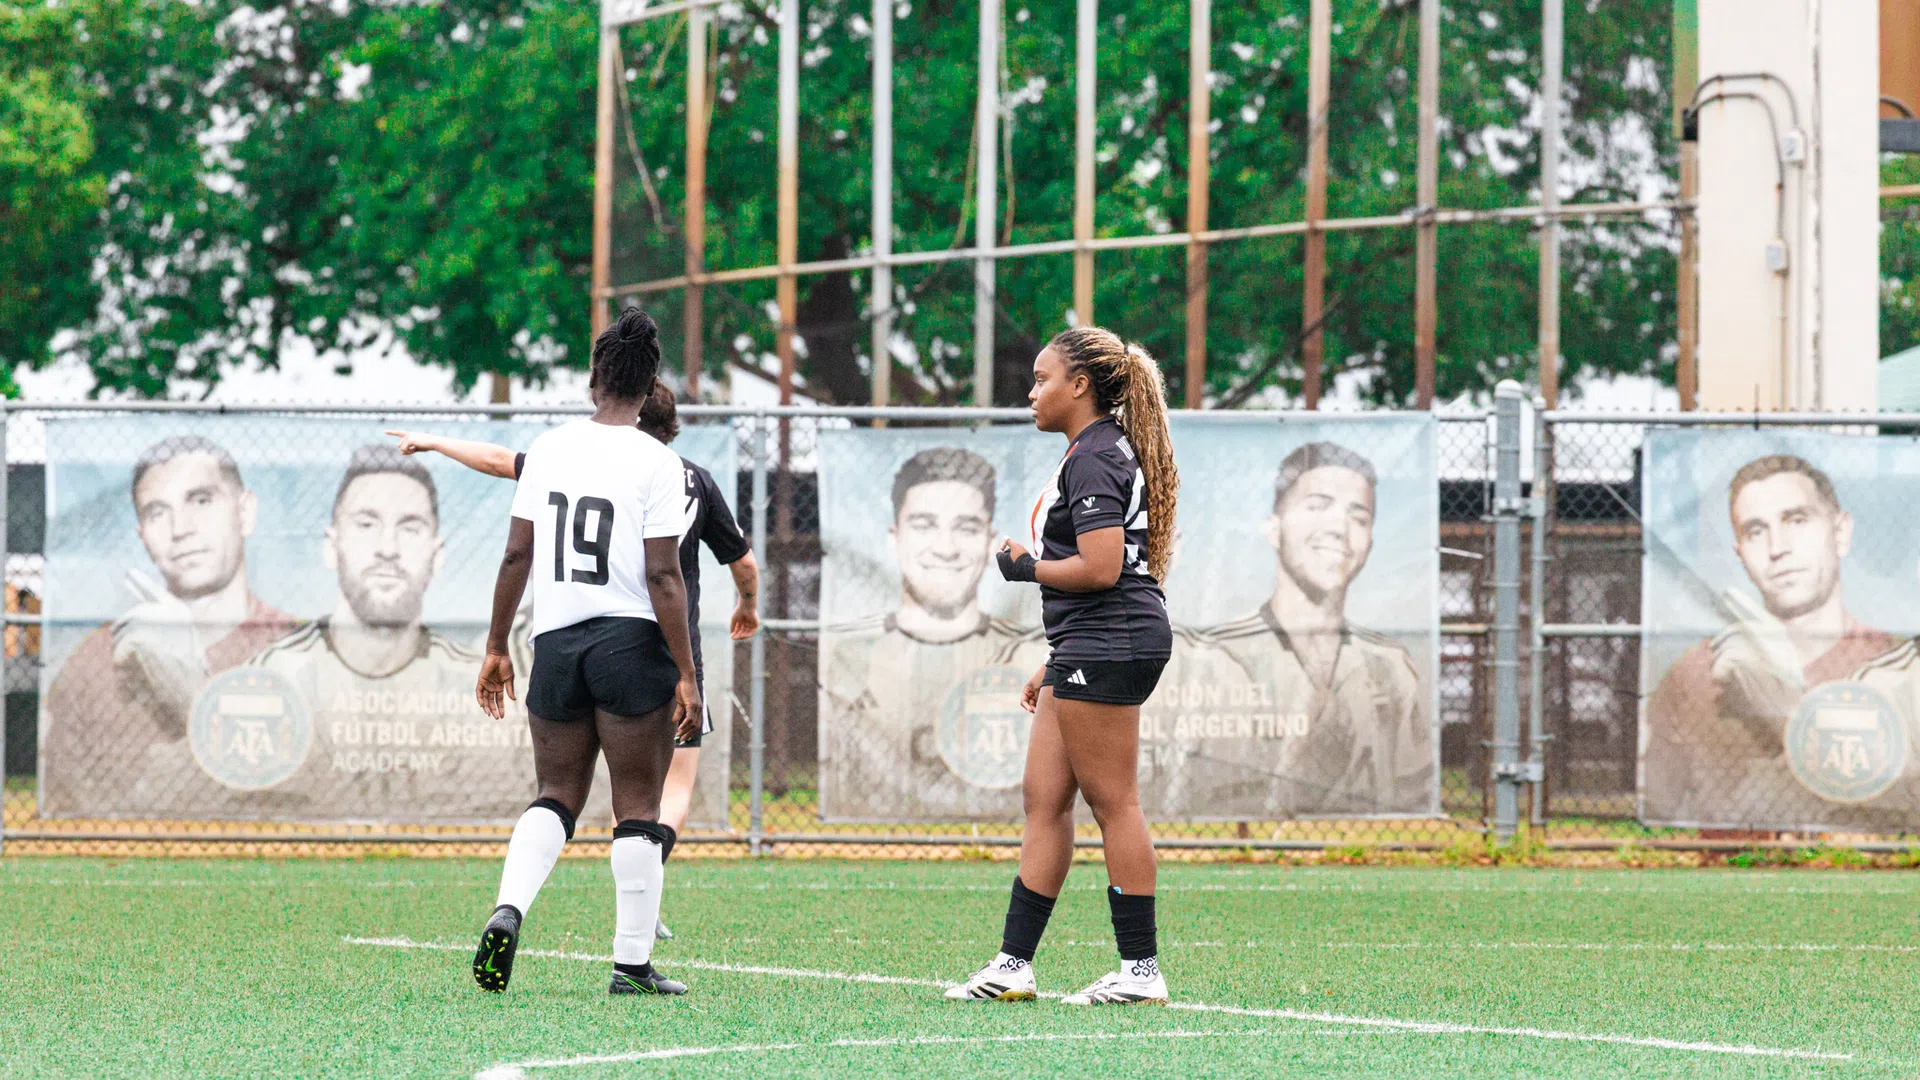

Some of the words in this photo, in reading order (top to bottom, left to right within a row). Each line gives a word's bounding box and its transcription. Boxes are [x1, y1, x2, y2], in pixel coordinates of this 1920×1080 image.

[548, 491, 615, 586] 19
[1230, 683, 1273, 706] DEL
[331, 716, 422, 745] FÚTBOL
[428, 720, 532, 747] ARGENTI
[1140, 713, 1168, 740] OL
[1173, 712, 1310, 738] ARGENTINO
[331, 750, 443, 773] ACADEMY
